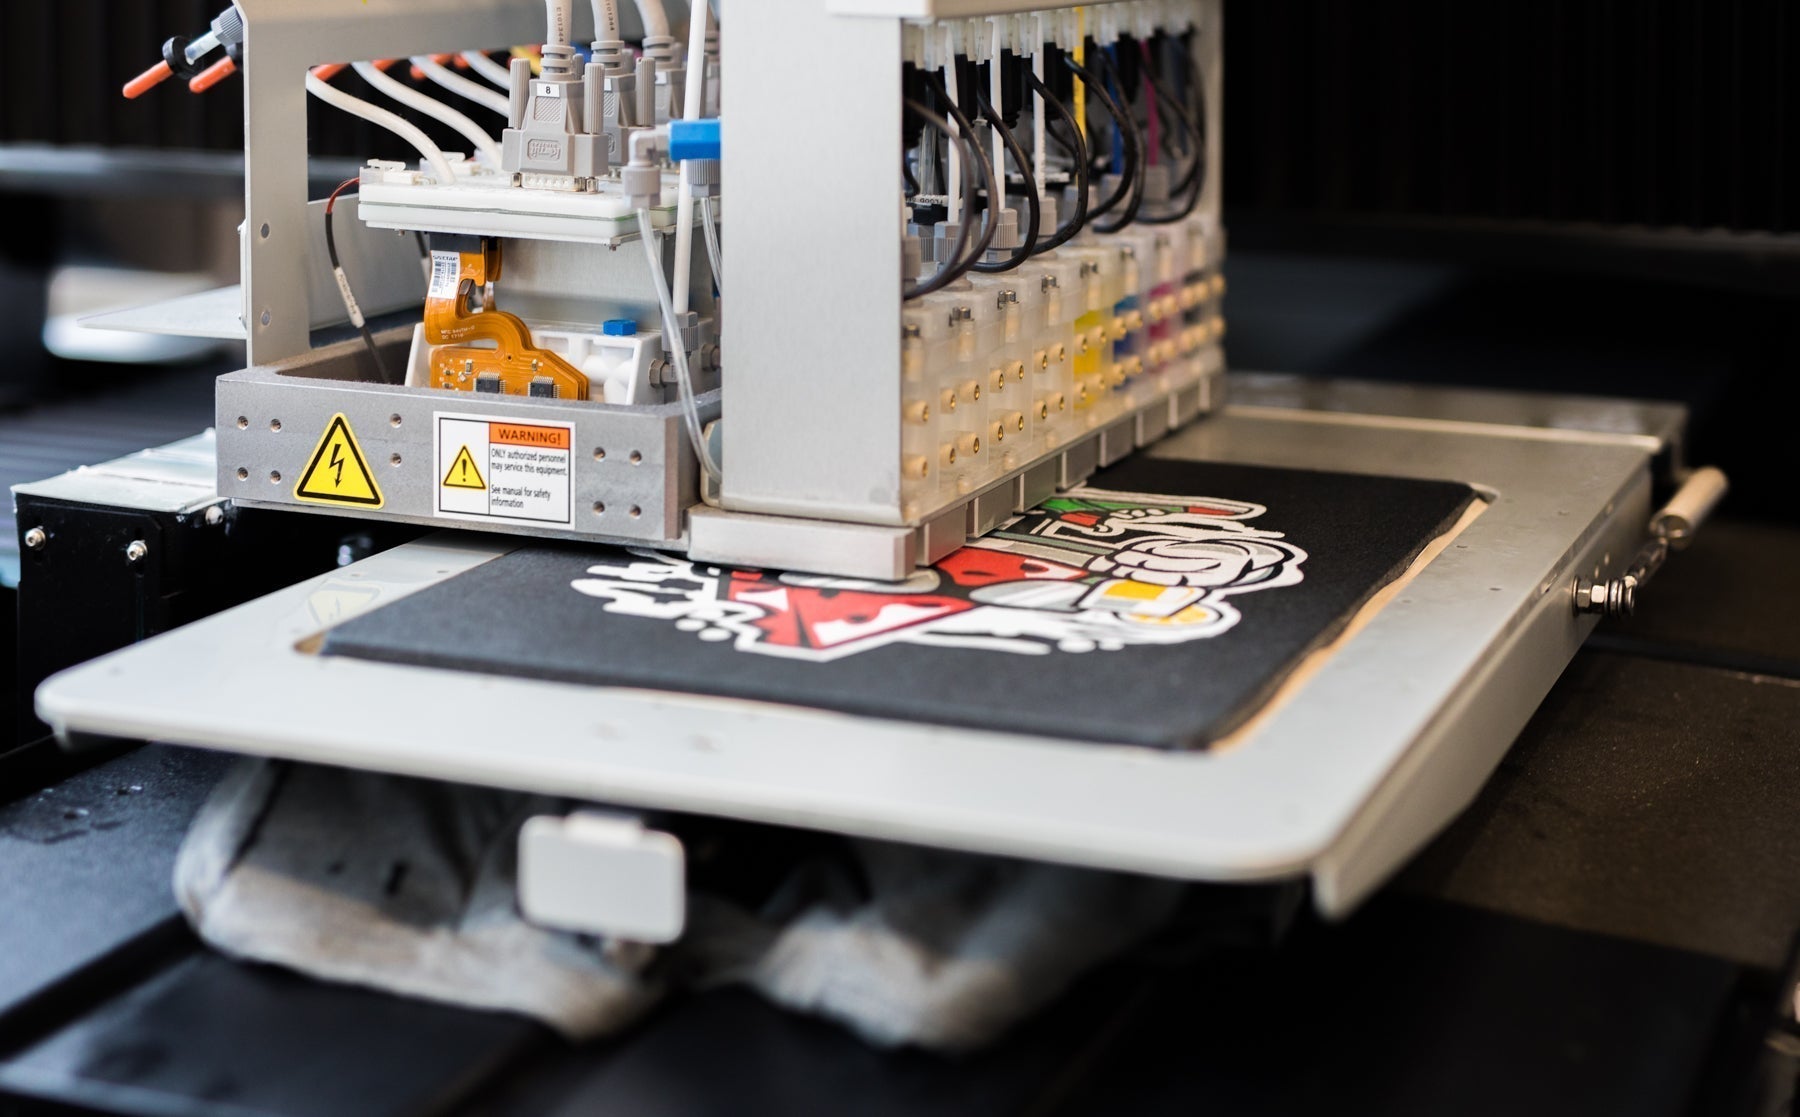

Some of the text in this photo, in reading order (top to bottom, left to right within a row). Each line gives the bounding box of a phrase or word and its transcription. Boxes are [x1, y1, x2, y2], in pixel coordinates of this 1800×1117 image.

[556, 6, 564, 42] E101344
[545, 86, 551, 95] 8
[497, 428, 561, 446] WARNING!
[491, 448, 566, 464] ONLY authorized personnel
[491, 462, 567, 477] may service this equipment.
[491, 484, 551, 503] See manual for safety
[491, 495, 524, 508] information
